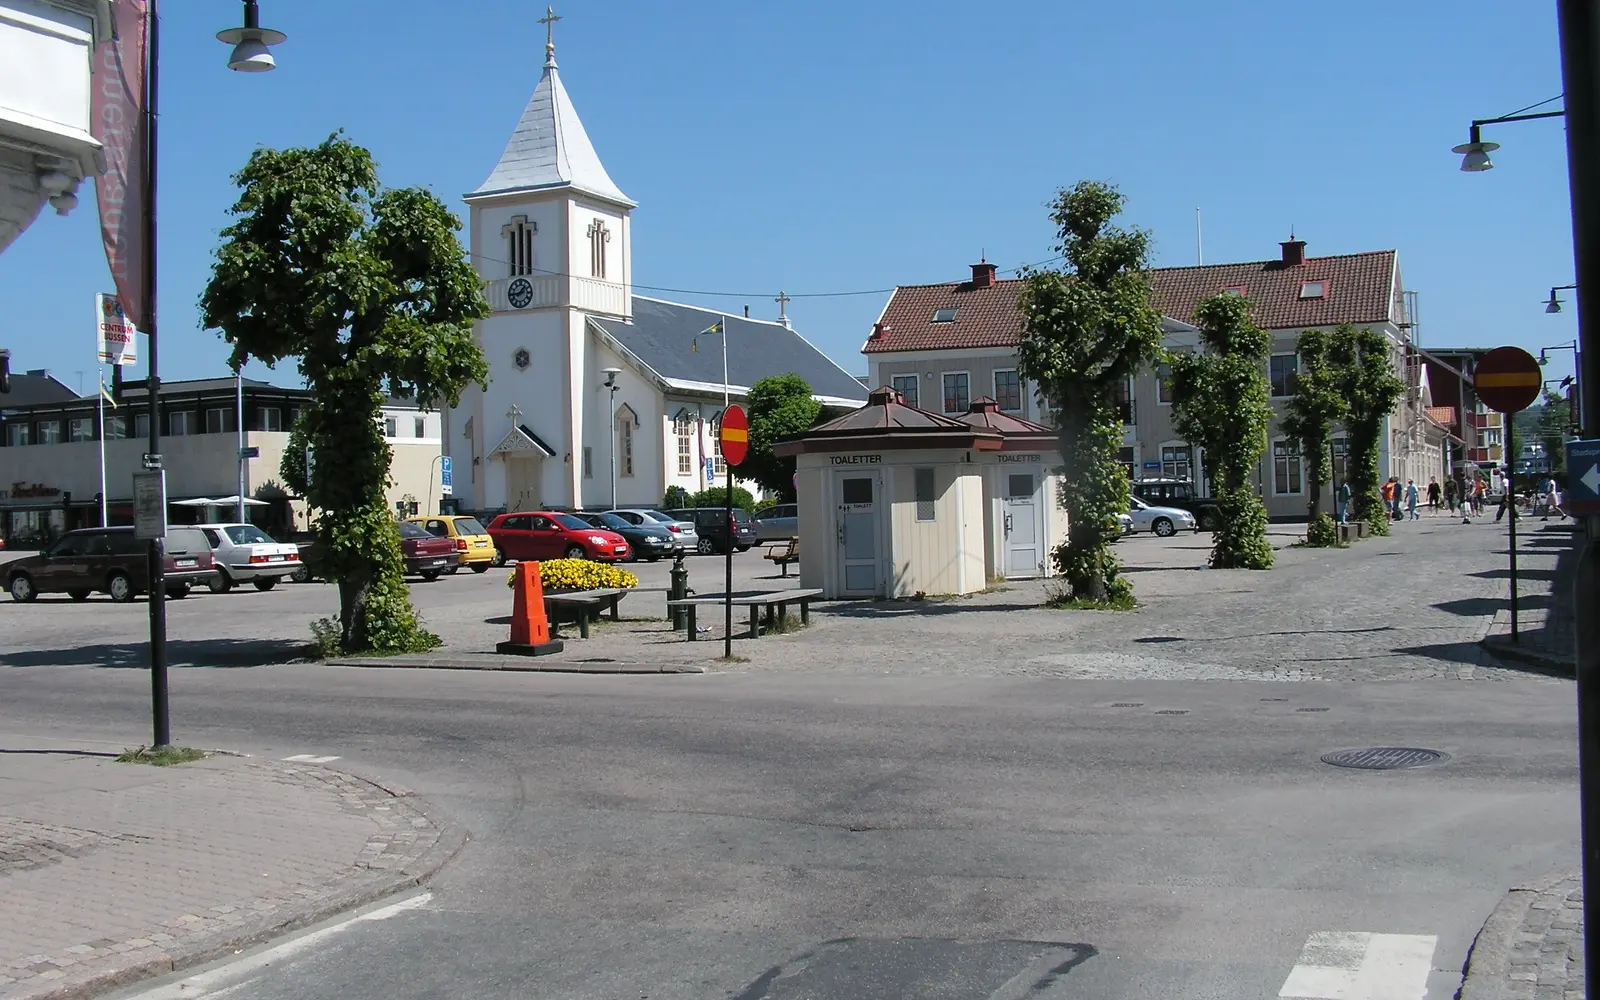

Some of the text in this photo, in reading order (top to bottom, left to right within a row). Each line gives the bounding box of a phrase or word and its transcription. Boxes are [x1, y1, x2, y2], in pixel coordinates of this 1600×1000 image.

[100, 323, 133, 334] CENTRUM
[104, 333, 130, 342] BUSSEN
[444, 458, 450, 470] P
[829, 455, 882, 465] TOALETTER
[997, 455, 1041, 463] TOALETTER
